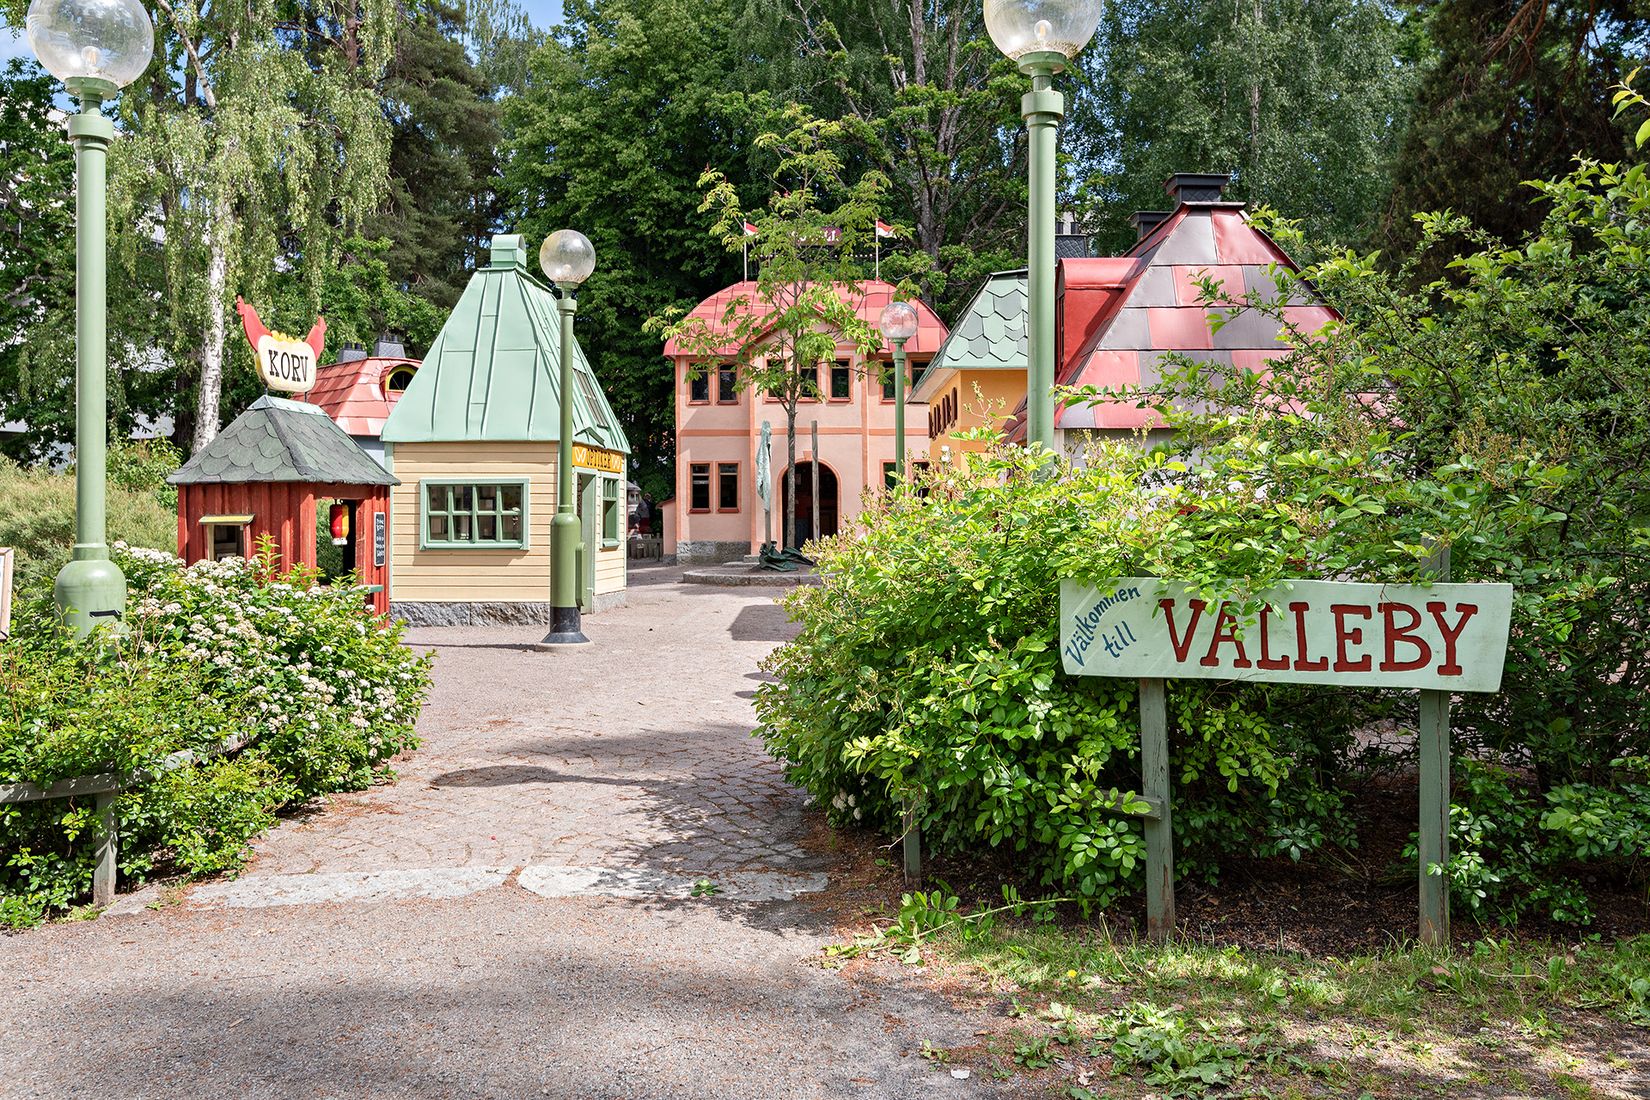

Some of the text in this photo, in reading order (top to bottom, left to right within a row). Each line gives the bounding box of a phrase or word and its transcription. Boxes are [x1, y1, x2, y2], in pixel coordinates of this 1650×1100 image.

[268, 349, 309, 382] KORV
[1065, 586, 1141, 667] Välkommen
[1102, 620, 1137, 658] till
[1158, 599, 1478, 675] VALLEBY
